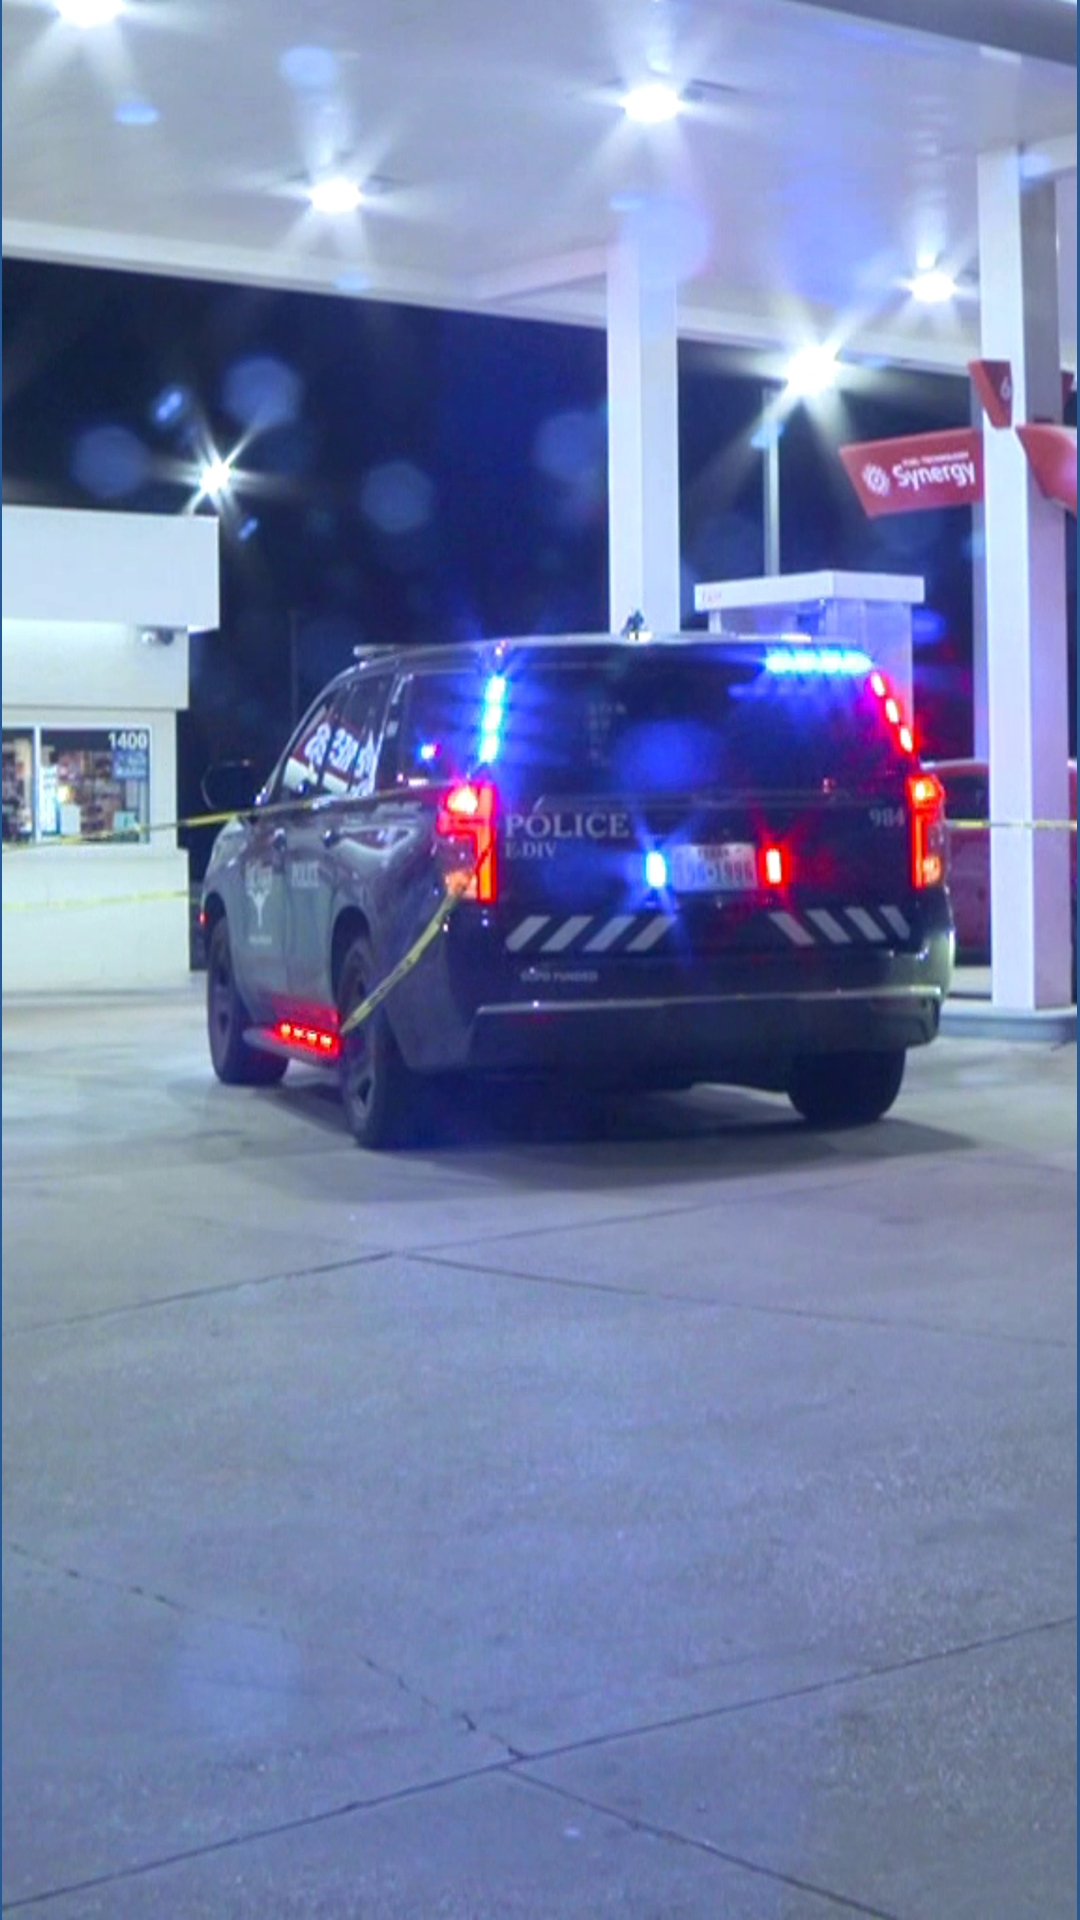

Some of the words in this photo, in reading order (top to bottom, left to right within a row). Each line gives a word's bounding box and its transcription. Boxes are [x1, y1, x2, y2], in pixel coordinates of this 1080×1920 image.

[891, 460, 976, 491] Synergy
[108, 732, 148, 750] 1400
[504, 813, 630, 839] POLICE
[869, 808, 906, 828] 984
